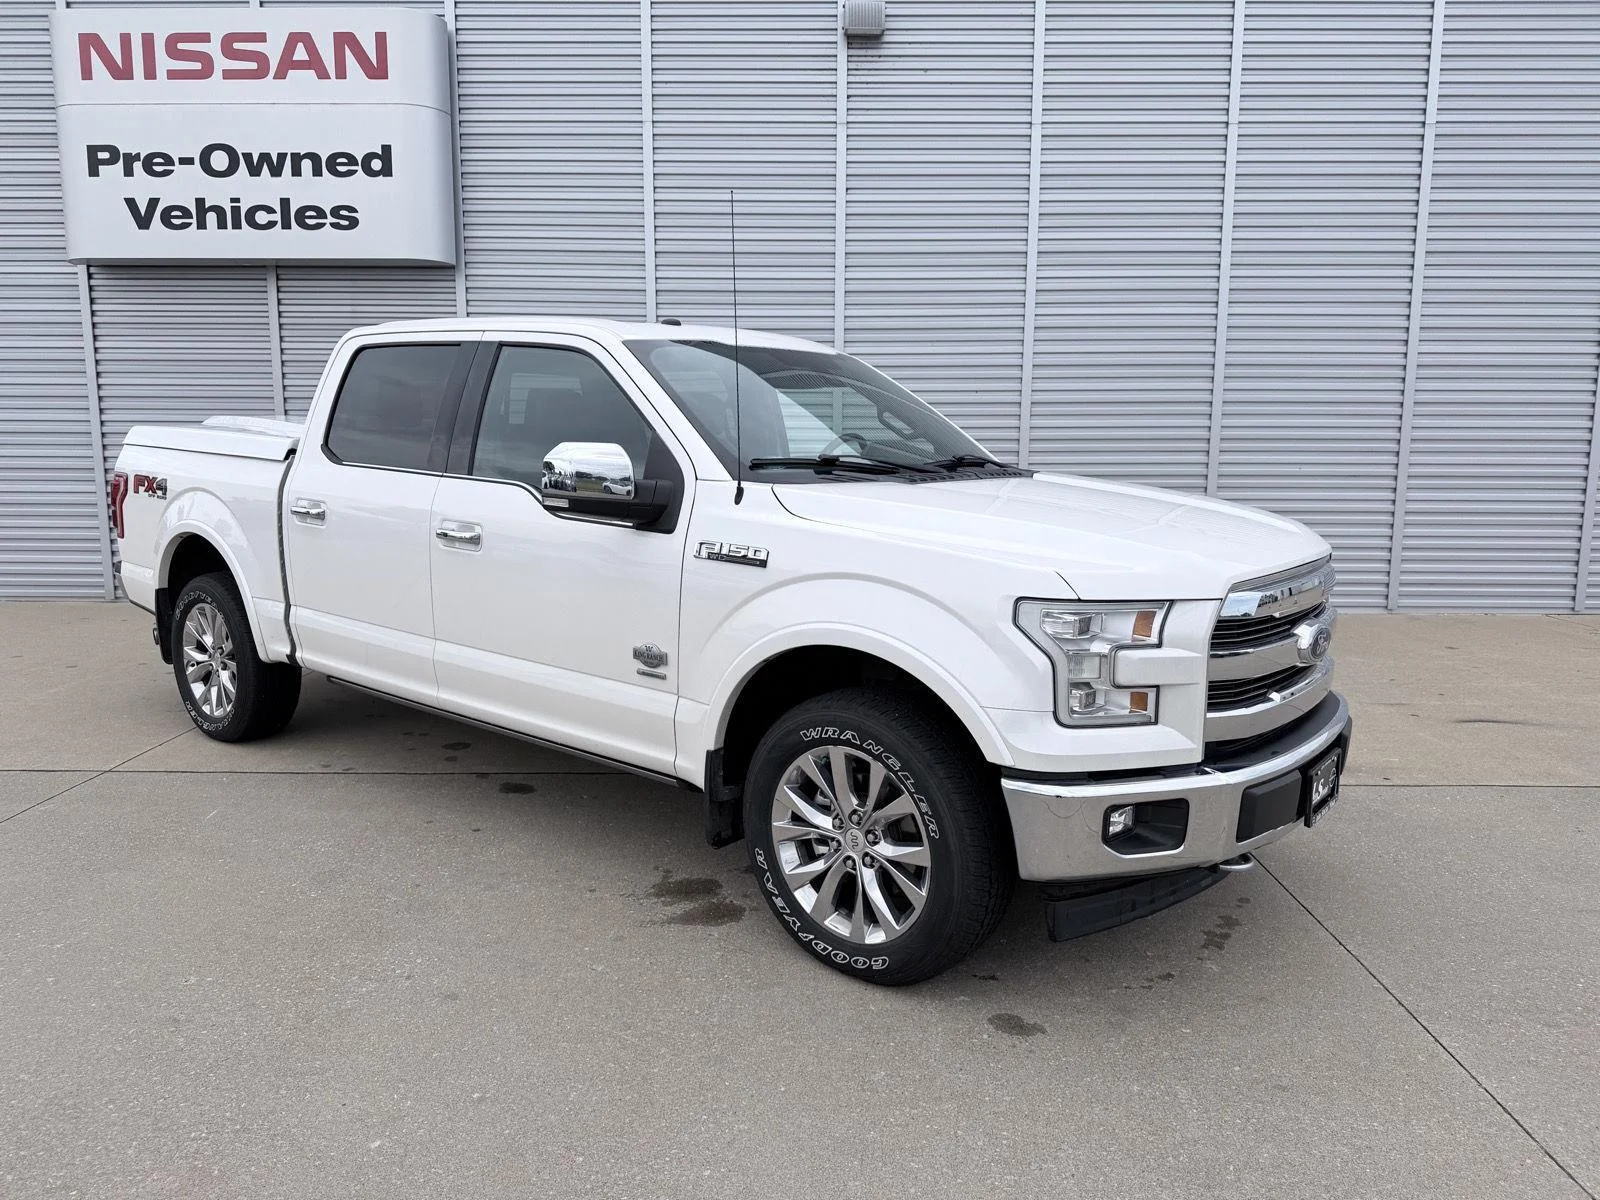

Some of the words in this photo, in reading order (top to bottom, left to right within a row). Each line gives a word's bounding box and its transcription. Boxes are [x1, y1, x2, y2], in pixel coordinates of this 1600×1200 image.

[78, 31, 389, 81] NISSAN
[86, 143, 394, 178] Pre-Owned
[124, 197, 360, 231] Vehicles
[133, 474, 168, 495] FX4
[800, 726, 939, 839] WRANGLER
[754, 847, 889, 969] GOODYEAR
